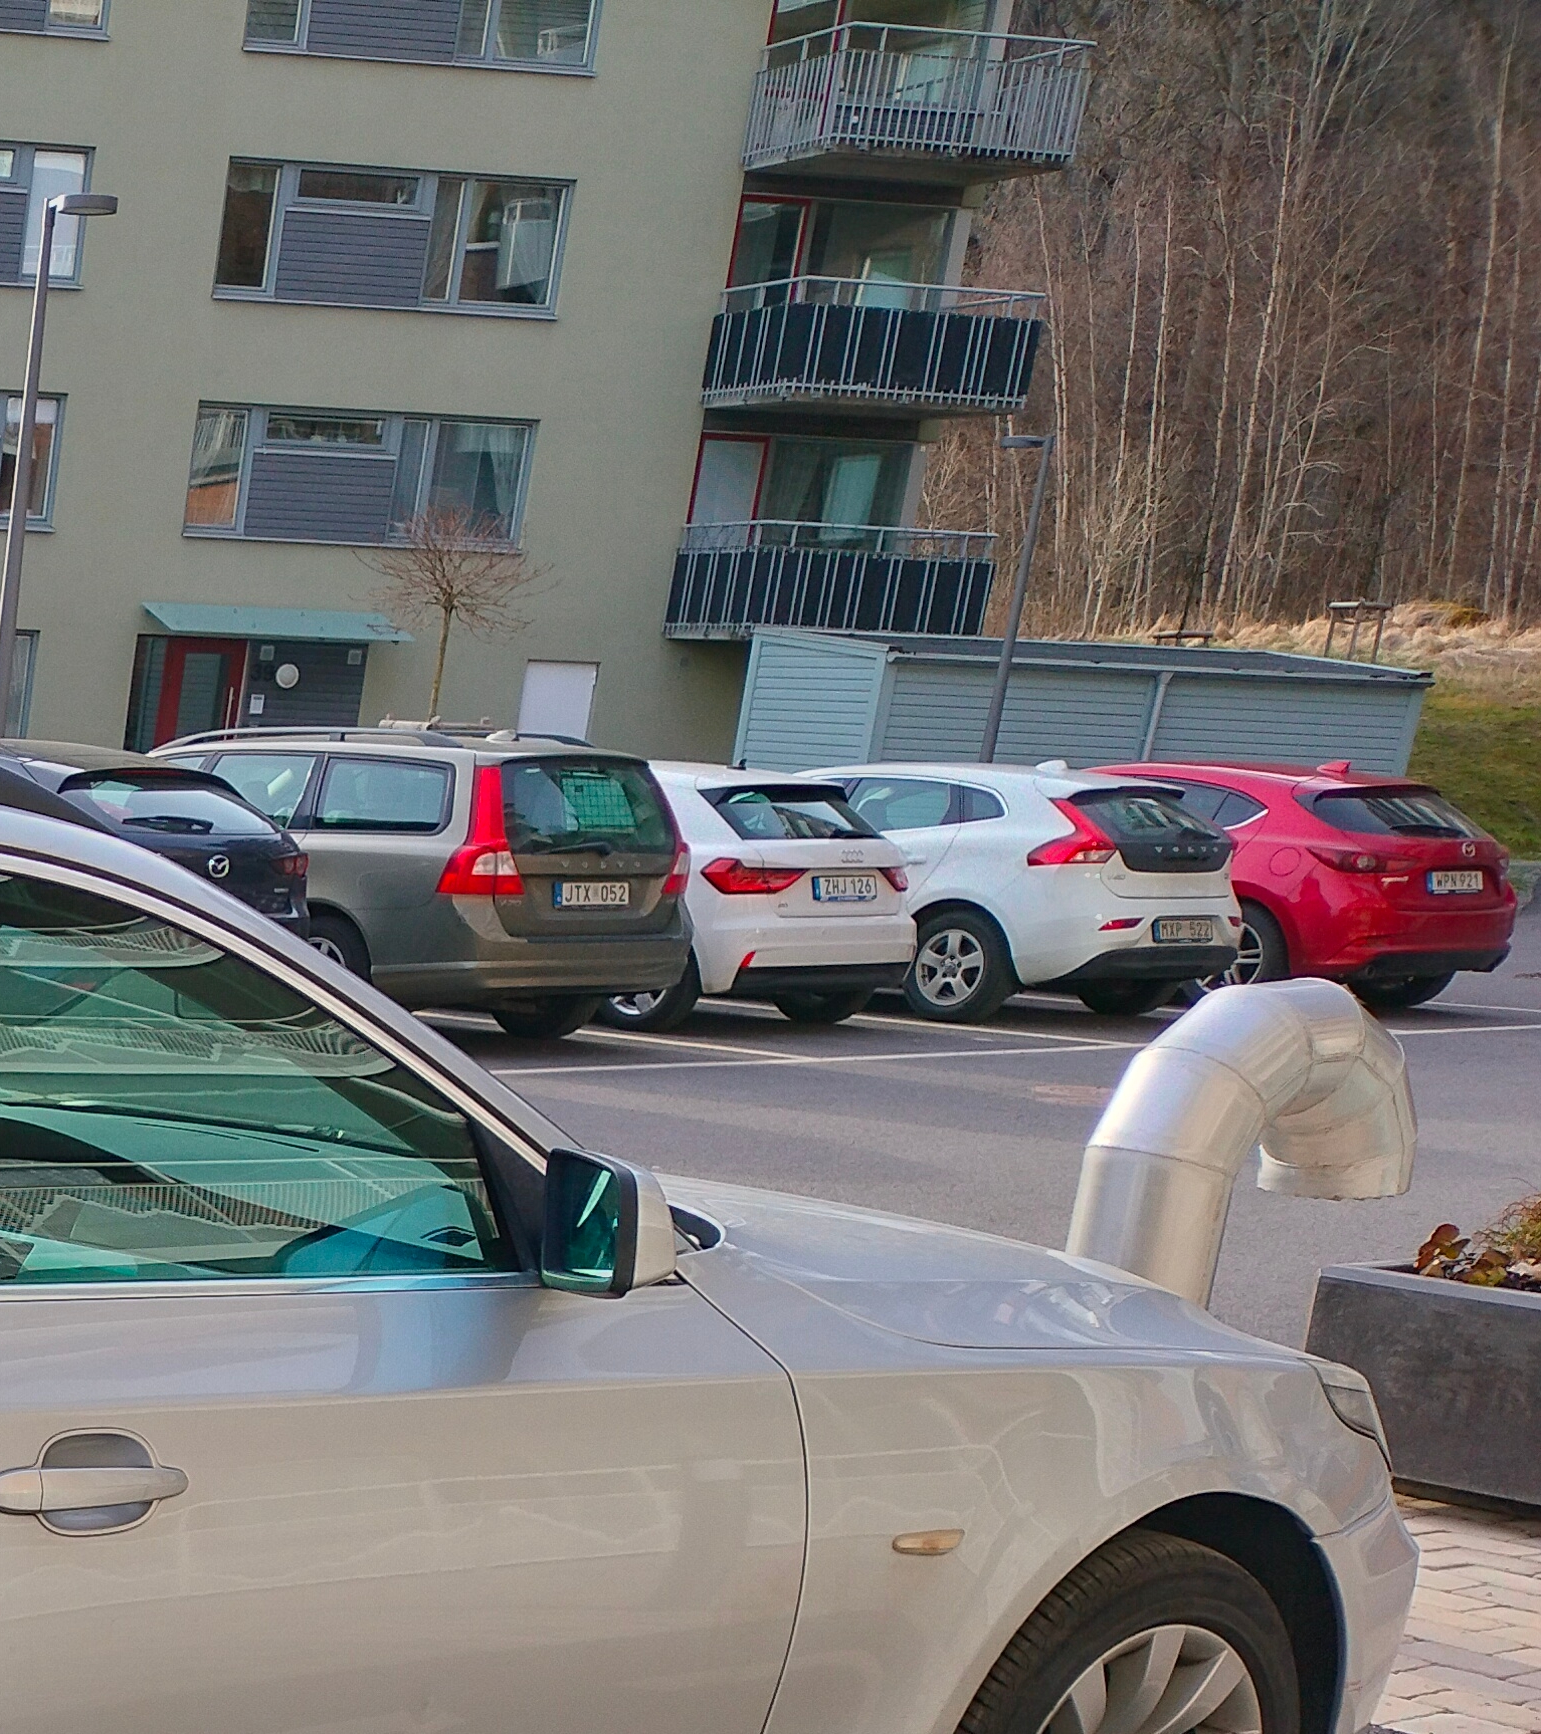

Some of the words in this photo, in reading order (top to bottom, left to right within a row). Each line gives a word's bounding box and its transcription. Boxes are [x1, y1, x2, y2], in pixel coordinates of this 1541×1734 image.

[1155, 846, 1218, 854] VOLVO
[561, 861, 641, 869] VOLVO
[565, 885, 591, 902] JTX
[600, 885, 626, 902] 052
[824, 878, 847, 895] ZHJ
[851, 878, 872, 894] 126
[1161, 920, 1182, 937] MXP
[1189, 921, 1210, 937] 522
